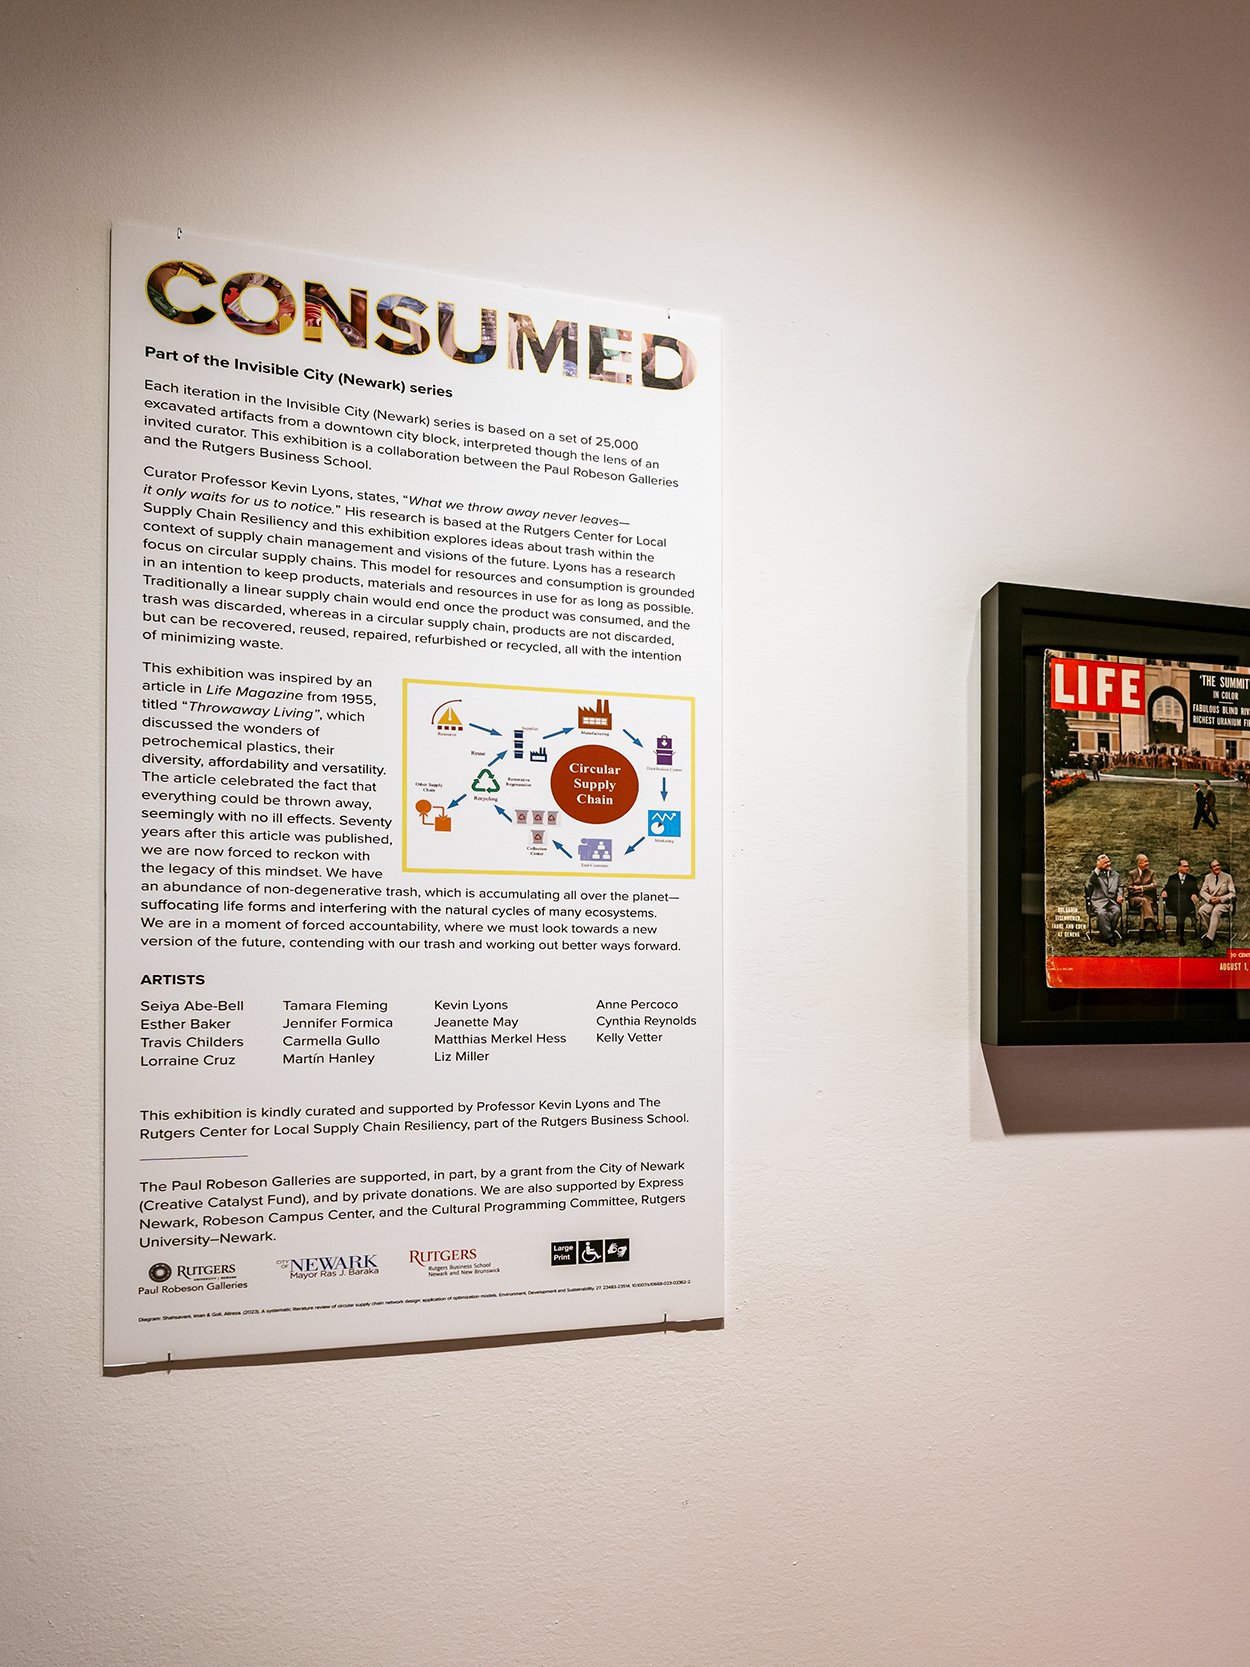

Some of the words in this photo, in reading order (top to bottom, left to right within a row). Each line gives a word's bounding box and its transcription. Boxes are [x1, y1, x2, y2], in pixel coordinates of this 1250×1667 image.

[144, 260, 699, 391] CONSUMED
[145, 345, 179, 362] Part
[182, 352, 200, 364] of
[203, 354, 230, 369] the
[234, 358, 299, 378] Invisible
[303, 367, 335, 385] City
[338, 372, 406, 394] (Newark)
[409, 384, 453, 398] series
[144, 379, 179, 394] Each
[183, 384, 240, 402] iteration
[244, 392, 257, 404] in
[260, 394, 283, 407] the
[286, 397, 341, 415] Invisible
[344, 405, 370, 421] City
[373, 409, 430, 428] (Newark)
[433, 418, 471, 431] series
[474, 421, 485, 433] is
[488, 423, 526, 437] based
[529, 430, 545, 440] on
[547, 432, 555, 441] a
[558, 434, 577, 444] set
[580, 435, 593, 445] of
[595, 436, 639, 451] 25,000
[1054, 664, 1141, 709] LIFE
[1213, 691, 1220, 699] IN
[1221, 692, 1239, 701] COLOR
[1192, 704, 1220, 714] FABULOUS
[1222, 706, 1238, 715] BLIND
[1192, 715, 1215, 725] RICHEST
[1217, 717, 1241, 727] URANIUM
[569, 763, 621, 775] Circular
[573, 778, 616, 792] Supply
[576, 793, 613, 805] Chain
[1220, 962, 1241, 971] AUGUST
[140, 974, 206, 986] ARTISTS
[140, 1000, 180, 1014] Seiya
[183, 1000, 244, 1012] Abe-Bell
[282, 1000, 332, 1011] Tamara
[336, 1000, 388, 1013] Fleming
[434, 999, 469, 1011] Kevin
[472, 1000, 509, 1013] Lyons
[595, 999, 628, 1010] Anne
[630, 999, 679, 1010] Percoco
[140, 1018, 187, 1030] Esther
[190, 1018, 232, 1030] Baker
[282, 1017, 337, 1029] Jennifer
[341, 1017, 393, 1029] Formica
[433, 1017, 489, 1028] Jeanette
[493, 1016, 519, 1030] May
[596, 1016, 641, 1029] Cynthia
[644, 1015, 697, 1028] Reynolds
[140, 1037, 182, 1049] Travis
[186, 1036, 244, 1048] Childers
[282, 1035, 342, 1047] Carmella
[345, 1035, 381, 1046] Gullo
[434, 1034, 488, 1045] Matthias
[491, 1033, 533, 1044] Merkel
[536, 1033, 567, 1044] Hess
[596, 1032, 625, 1045] Kelly
[627, 1032, 663, 1043] Vetter
[140, 1055, 199, 1067] Lorraine
[203, 1054, 236, 1066] Cruz
[282, 1052, 325, 1065] Martín
[328, 1052, 376, 1066] Hanley
[434, 1051, 452, 1062] Liz
[455, 1051, 490, 1062] Miller
[289, 1254, 378, 1272] NEWARK
[409, 1248, 477, 1267] RUTGERS
[177, 1264, 236, 1279] RUTGERS
[290, 1271, 318, 1280] Mayor
[320, 1270, 337, 1278] Ras
[339, 1269, 347, 1277] J.
[348, 1267, 379, 1276] Baraka
[474, 1267, 500, 1275] Brunswick
[138, 1285, 159, 1295] Paul
[161, 1284, 204, 1294] Robeson
[206, 1281, 249, 1291] Galleries
